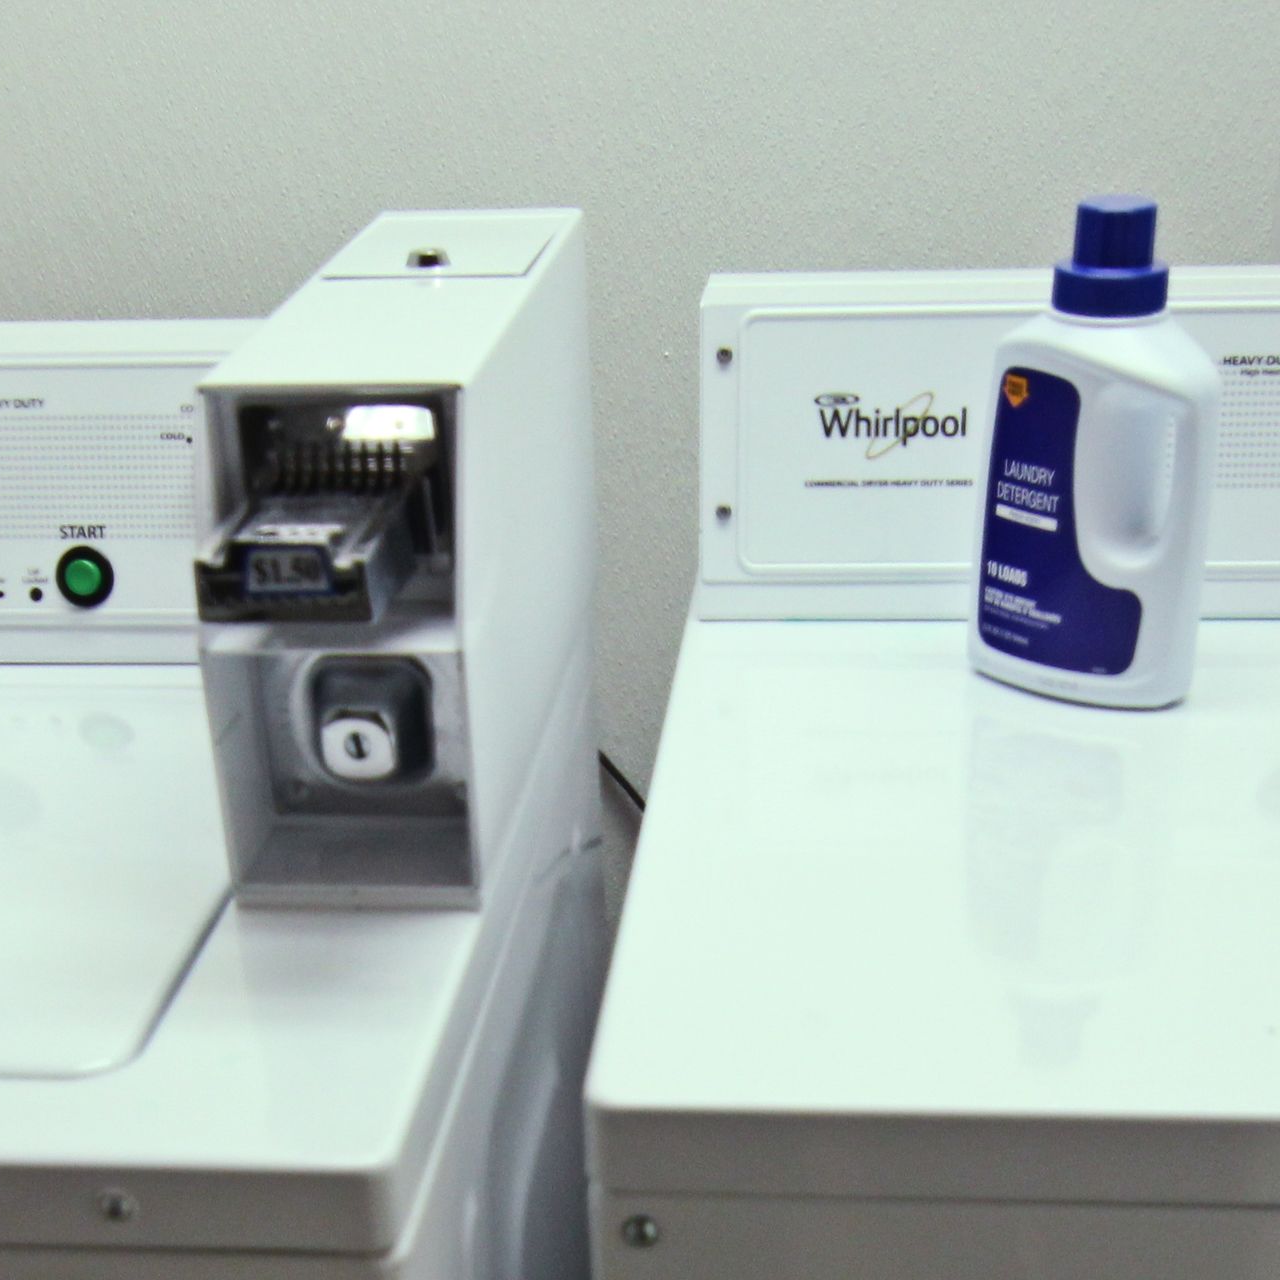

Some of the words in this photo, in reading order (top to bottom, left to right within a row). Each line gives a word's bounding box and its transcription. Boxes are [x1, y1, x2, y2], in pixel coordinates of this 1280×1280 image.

[1223, 355, 1263, 366] HEAVY
[14, 399, 44, 410] DUTY
[819, 407, 967, 447] Whirlpool
[160, 432, 185, 441] COLD
[1004, 459, 1056, 486] LAUNDRY
[805, 479, 858, 488] COMMERCIAL
[860, 479, 889, 487] DRYER
[891, 479, 919, 487] HEAVY
[921, 479, 944, 487] DUTY
[946, 478, 973, 487] SERIES
[996, 480, 1060, 513] DETERGENT
[59, 525, 106, 539] START
[987, 560, 998, 577] 10
[998, 564, 1028, 587] LOADS
